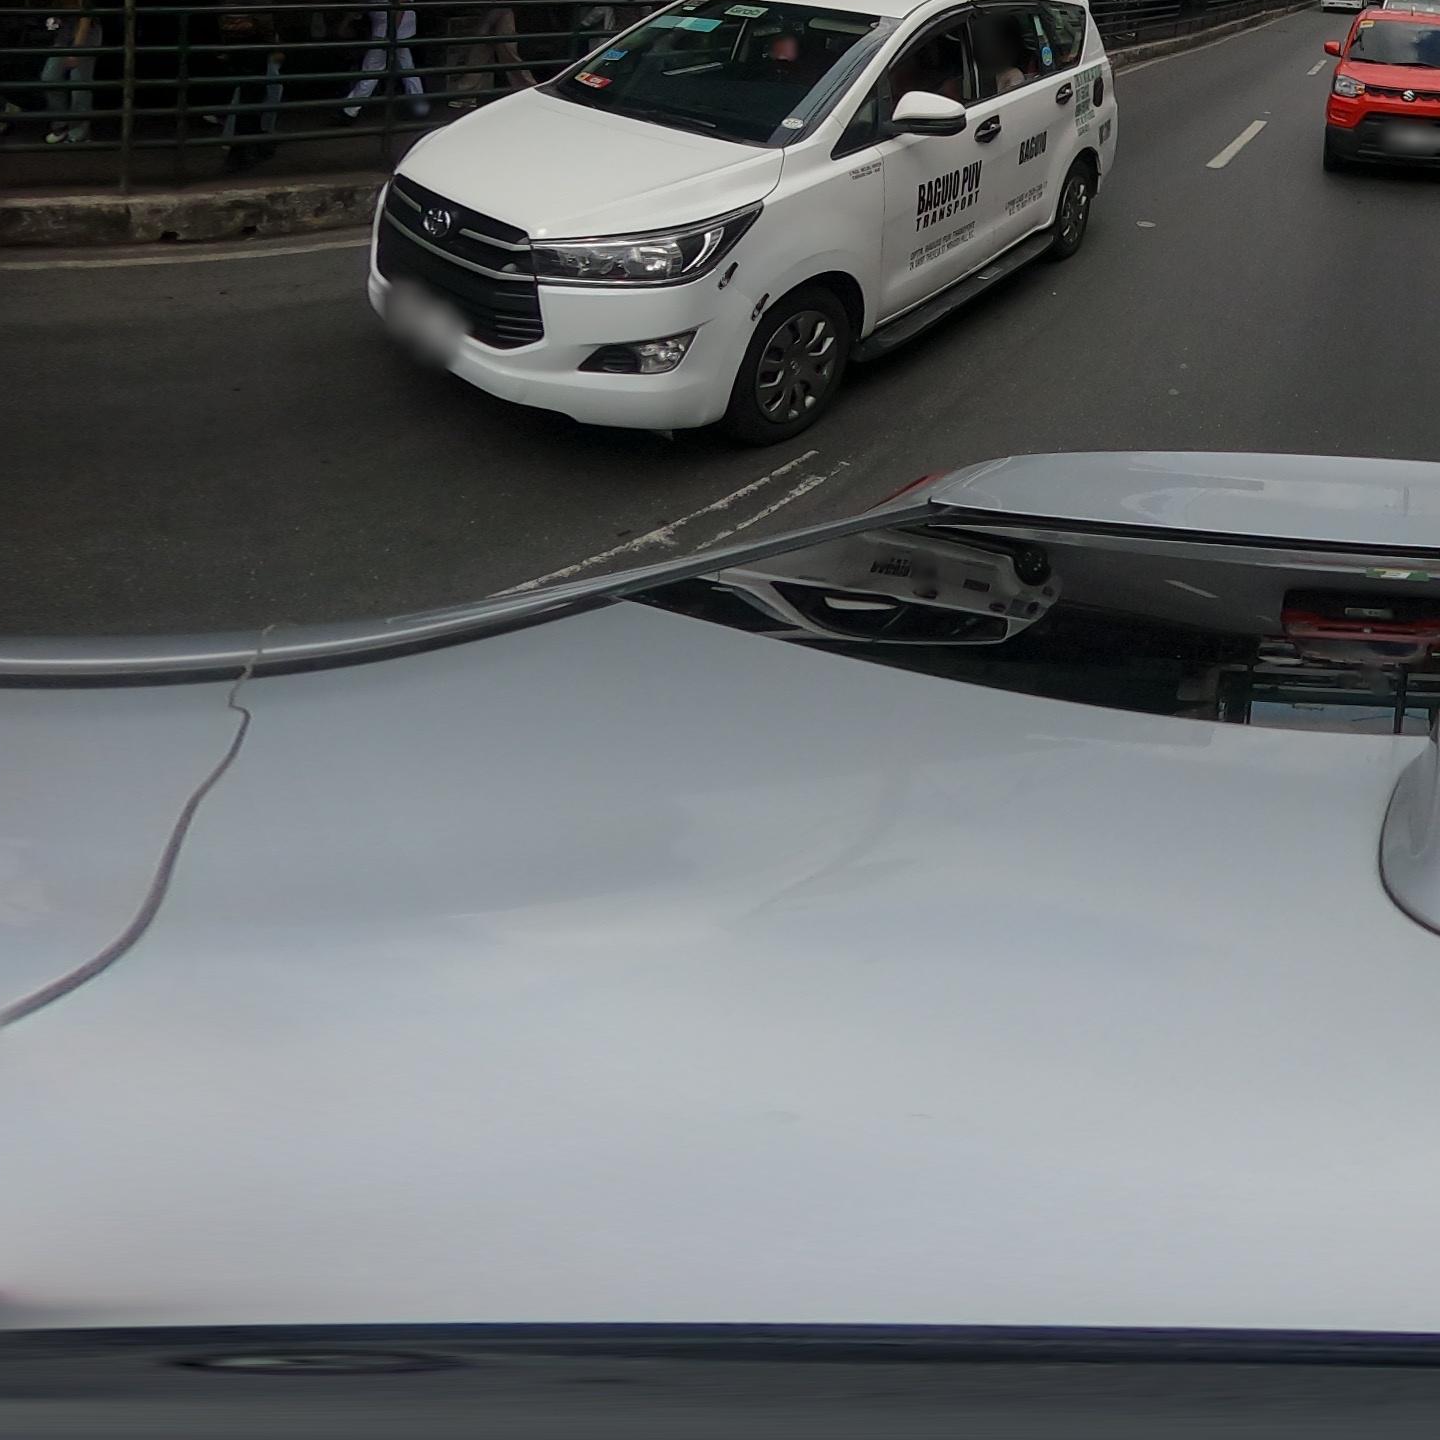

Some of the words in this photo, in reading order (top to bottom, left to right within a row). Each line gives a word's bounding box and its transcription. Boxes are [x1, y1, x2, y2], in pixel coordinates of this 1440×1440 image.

[1018, 131, 1048, 165] BAGUIO
[916, 169, 960, 216] BAGUIO
[961, 159, 983, 193] PUV
[915, 189, 980, 232] TRANSPORT
